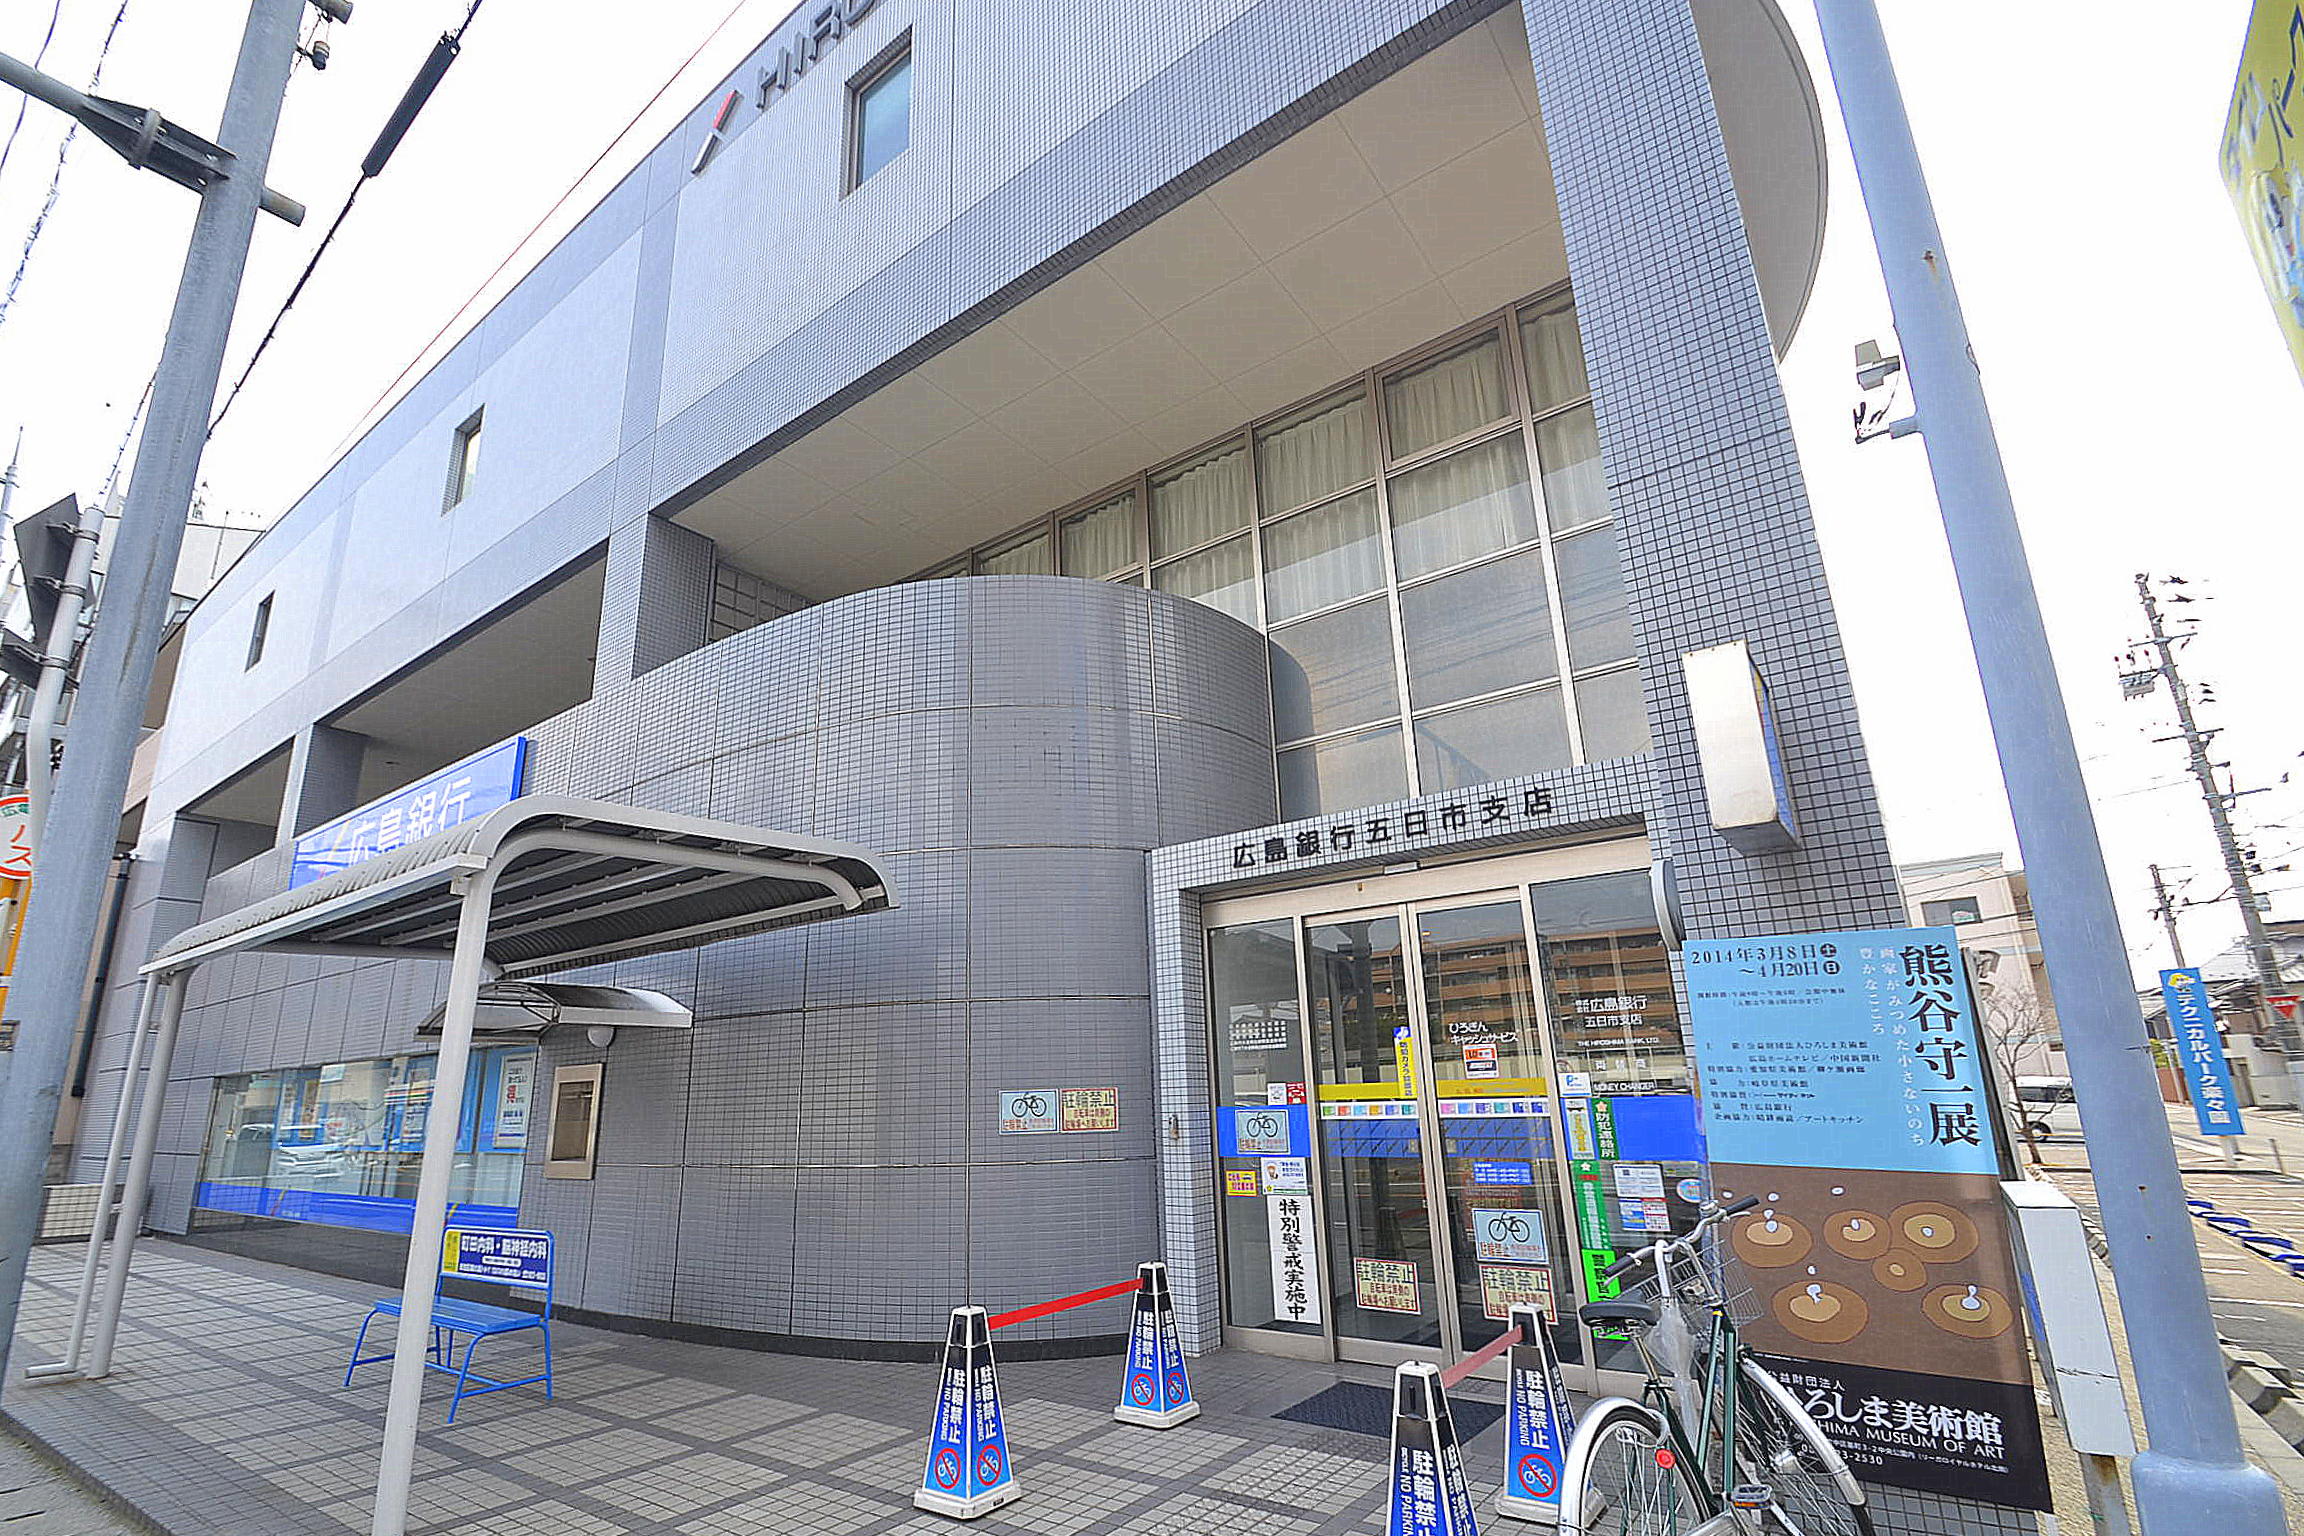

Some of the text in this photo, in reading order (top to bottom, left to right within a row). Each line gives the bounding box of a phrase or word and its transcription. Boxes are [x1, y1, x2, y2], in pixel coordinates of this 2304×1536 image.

[1233, 786, 1552, 869] 広島銀行五日市支店
[1859, 948, 1884, 1035] 豊かなこころ
[1449, 1021, 1489, 1034] ひろぎん
[1450, 1032, 1519, 1045] キャッシュサービス
[1585, 1013, 1643, 1028] 五日市支店
[1899, 944, 1983, 1147] 熊谷守一展
[2177, 994, 2232, 1124] テクニカルパーク楽々園
[1062, 1090, 1116, 1108] 駐輪禁止
[1593, 1081, 1655, 1092] MONEY CHANGER
[1596, 1112, 1615, 1158] 防犯連絡所
[1279, 1198, 1308, 1320] 特別警戒実施中
[1357, 1260, 1415, 1283] 駐輪禁止
[1482, 1268, 1550, 1292] 駐輪禁止
[1142, 1310, 1155, 1370] 駐輪禁止
[1164, 1309, 1180, 1369] 駐輪禁止
[948, 1368, 966, 1445] 駐輪禁止
[980, 1364, 998, 1440] 駐輪禁止
[1516, 1388, 1526, 1405] NO
[1525, 1369, 1551, 1450] 駐輪禁止
[940, 1401, 951, 1441] PARKING
[1517, 1405, 1530, 1447] PARKING
[1866, 1427, 1937, 1450] MUSEUM
[1943, 1439, 1966, 1454] OF
[1974, 1443, 2005, 1460] ART
[1400, 1474, 1412, 1493] NO
